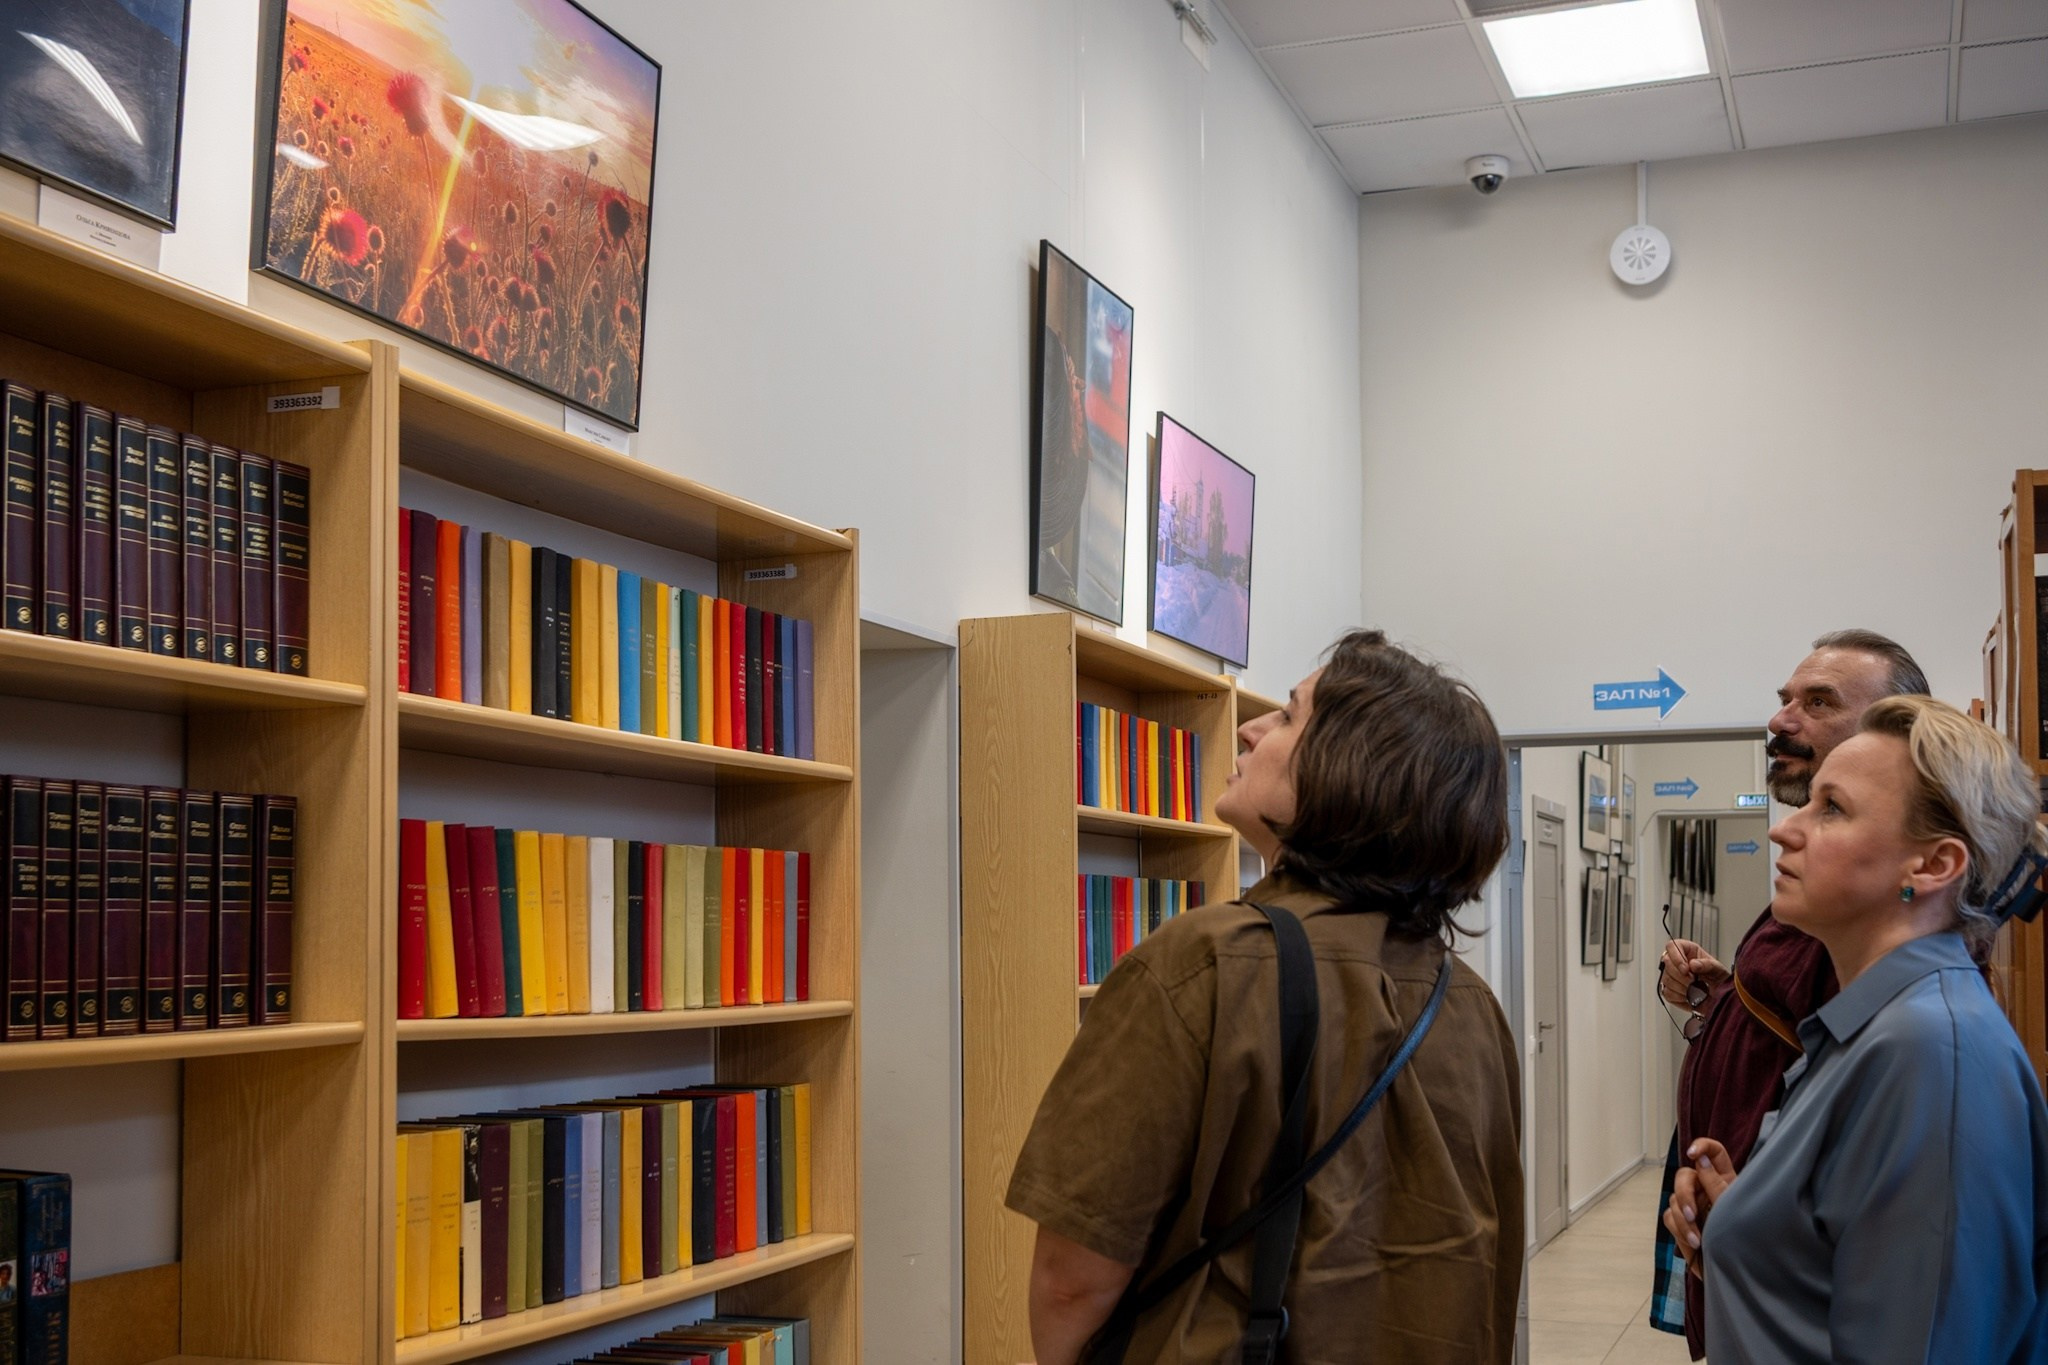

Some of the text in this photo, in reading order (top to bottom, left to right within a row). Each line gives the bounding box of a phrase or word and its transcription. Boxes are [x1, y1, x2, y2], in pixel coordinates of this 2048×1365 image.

[273, 396, 322, 409] 393363392
[1595, 689, 1635, 702] ЗАЛ
[1655, 785, 1675, 793] ЗАЛ
